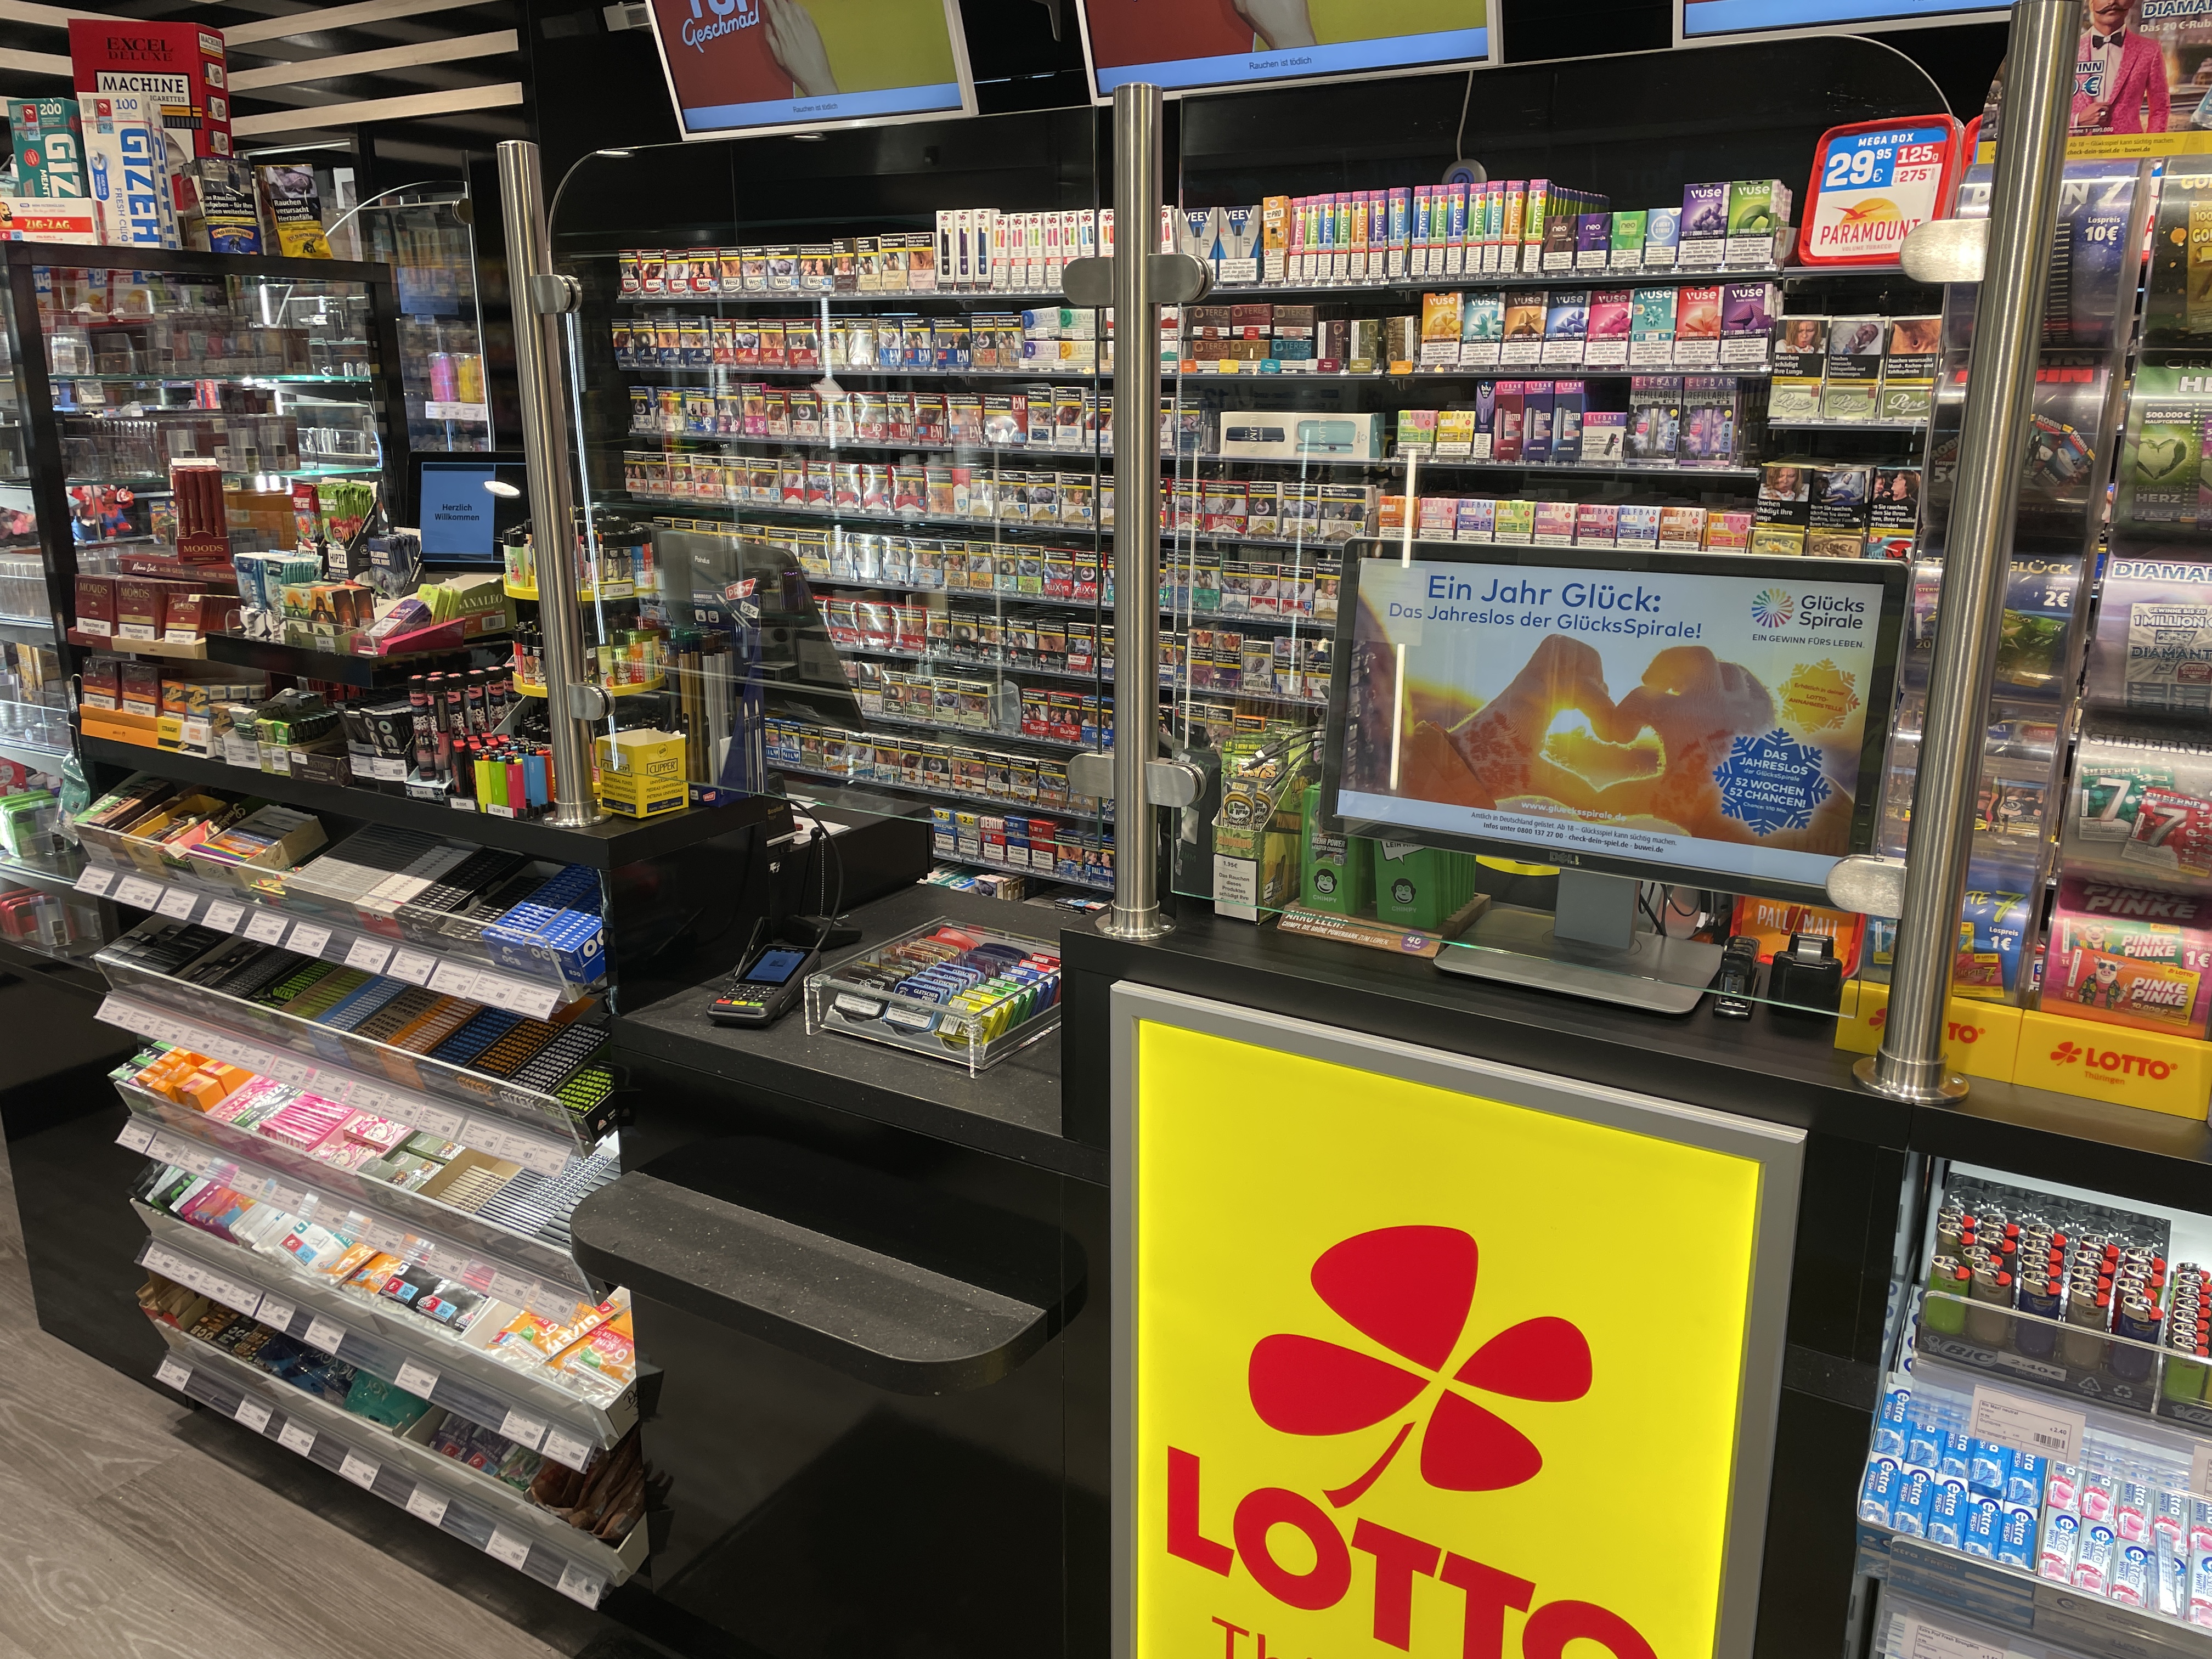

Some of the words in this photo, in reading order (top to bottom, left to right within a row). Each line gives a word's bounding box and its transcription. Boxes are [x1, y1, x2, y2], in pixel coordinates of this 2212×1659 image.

[2141, 23, 2160, 32] Das
[2163, 22, 2177, 31] 20
[107, 37, 173, 52] EXCEL
[108, 50, 173, 61] DELUXE
[1249, 61, 1279, 69] Rauchen
[1290, 57, 1312, 65] tödlich
[103, 76, 184, 93] MACHINE
[40, 103, 61, 115] 200
[116, 98, 137, 109] 100
[1858, 136, 1887, 147] MEGA
[1891, 133, 1914, 144] BOX
[1898, 145, 1939, 164] 125g
[1826, 150, 1875, 187] 29
[120, 128, 162, 242] GIZEH
[115, 188, 124, 216] FRESH
[1183, 211, 1212, 222] VEEV
[1224, 210, 1254, 220] VEEV
[25, 219, 70, 229] ZIG-ZAG
[2085, 225, 2119, 241] 10€
[1244, 307, 1268, 315] TEREA
[1634, 391, 1676, 399] REFILLABLE
[1687, 391, 1730, 399] REFILLABLE
[1830, 394, 1869, 414] Pepe
[2135, 493, 2181, 503] HERZ
[442, 504, 472, 512] Herzlich
[434, 513, 479, 521] Willkommen
[183, 544, 224, 552] MOODS
[329, 553, 346, 564] HIPZZ
[79, 583, 108, 595] MOODS
[121, 588, 149, 598] MOODS
[1428, 575, 1471, 601] Ein
[1481, 578, 1552, 605] Jahr
[1561, 583, 1661, 613] Glück:
[1801, 595, 1865, 612] Glücks
[2043, 591, 2069, 607] 2€
[1389, 602, 1423, 619] Das
[1427, 606, 1515, 627] Jahreslos
[1520, 611, 1551, 628] der
[1557, 614, 1702, 639] GlücksSpirale!
[1799, 611, 1863, 630] Spirale
[2143, 615, 2205, 628] MILLION
[1769, 635, 1805, 644] GEWINN
[1808, 637, 1831, 646] FÜRS
[1795, 682, 1820, 691] Erhältlich
[1788, 698, 1843, 712] ANNAHMESTELLE
[1764, 749, 1788, 761] DAS
[650, 761, 675, 773] CLIPPER
[1739, 757, 1808, 775] JAHRESLOS
[1756, 770, 1800, 782] GlücksSpirale
[1735, 777, 1748, 787] 52
[1751, 780, 1804, 796] WOCHEN
[1729, 787, 1742, 797] 52
[1745, 789, 1806, 808] CHANCEN!
[2097, 777, 2131, 822] 7
[1521, 801, 1627, 822] www.gluecksspirale.de
[1471, 812, 1492, 820] Amtlich
[1499, 815, 1533, 826] Deutschland
[1534, 820, 1555, 829] gelistet.
[1581, 827, 1613, 837] Glücksspiel
[1614, 831, 1628, 839] kann
[1630, 833, 1651, 844] süchtig
[1652, 836, 1677, 845] machen.
[2153, 806, 2188, 848] 7
[1327, 839, 1345, 847] POWER
[1568, 834, 1629, 848] check-dein-spiel.de
[1634, 843, 1663, 853] buwei.de
[1229, 874, 1250, 882] Rauchen
[1222, 885, 1246, 894] Produktes
[1313, 894, 1338, 904] CHIMPY
[2085, 896, 2198, 919] PINKE
[1282, 921, 1300, 930] CHIMPY,
[1311, 925, 1327, 935] GRÜNE
[1328, 928, 1358, 940] POWERBANK
[1358, 934, 1369, 942] ZUM
[1989, 926, 2018, 936] Lospreis
[2121, 935, 2175, 946] PINKE
[2124, 945, 2177, 957] PINKE
[502, 955, 521, 966] OCB
[913, 989, 938, 998] GLETSCHER
[2086, 1047, 2170, 1080] LOTTO
[2084, 1070, 2125, 1085] Thüringen
[499, 1091, 536, 1111] GIZEH
[1867, 1471, 1876, 1490] FRESH
[1934, 1493, 1943, 1513] FRESH
[2047, 1529, 2056, 1549] WHITE
[2082, 1541, 2091, 1560] WHITE
[2118, 1561, 2126, 1581] WHITE
